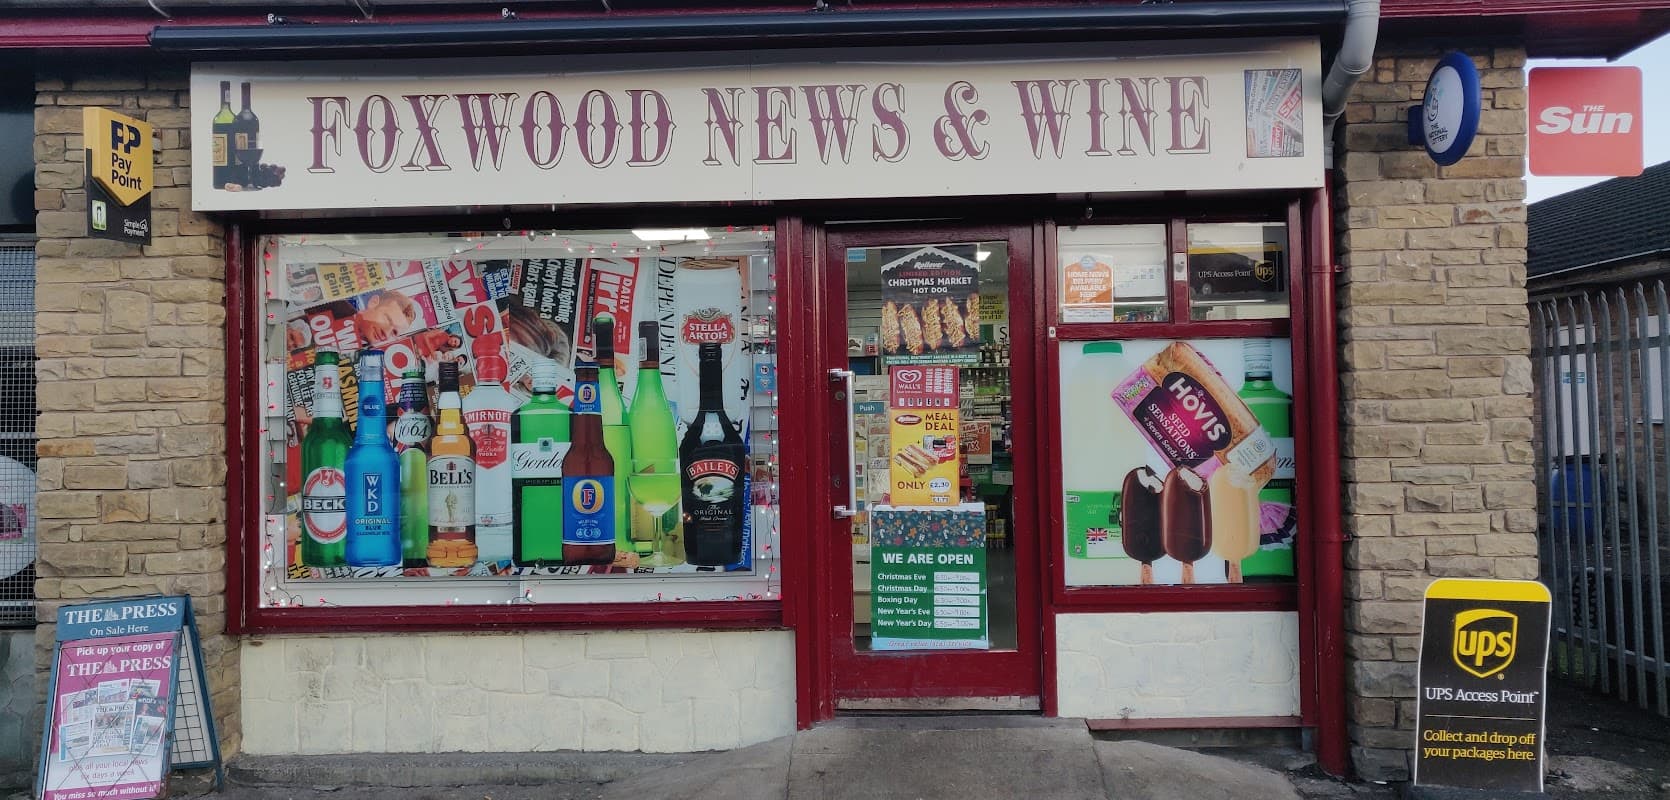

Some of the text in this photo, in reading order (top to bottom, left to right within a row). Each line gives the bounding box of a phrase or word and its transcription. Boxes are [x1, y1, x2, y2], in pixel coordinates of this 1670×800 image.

[1583, 104, 1605, 112] THE
[307, 88, 676, 173] FOXWOOD
[701, 83, 910, 167] NEWS
[933, 80, 990, 160] &
[1010, 76, 1211, 161] WINE
[1536, 106, 1633, 135] Sun
[111, 152, 132, 174] Pay
[111, 170, 142, 190] Point
[541, 259, 560, 289] Cheryl
[1198, 270, 1251, 279] UPS Access Point
[1257, 265, 1273, 278] ups
[324, 272, 340, 297] gain
[888, 277, 972, 287] CHRISTMAS MARKET
[522, 283, 538, 308] again
[619, 278, 632, 313] DAILY
[689, 322, 727, 332] STELLA
[689, 330, 728, 340] ARTOIS
[925, 413, 954, 421] MEAL
[1168, 377, 1227, 443] HOVIS
[925, 423, 955, 431] DEAL
[1148, 403, 1197, 459] SENSATIONS
[1168, 412, 1191, 438] SEED
[1146, 420, 1179, 460] Seven Seeds
[689, 460, 737, 477] BAILEYS
[430, 469, 473, 485] BELL'S
[897, 481, 925, 489] ONLY
[882, 553, 974, 565] WE ARE OPEN
[877, 584, 912, 592] Christmas
[914, 585, 928, 593] Day
[877, 596, 918, 604] Boxing Day
[65, 602, 177, 625] THE PRESS
[90, 624, 149, 636] On Sale Here
[896, 619, 916, 627] Year's
[918, 620, 932, 628] Day
[77, 641, 165, 656] Pick up your copy of
[1458, 630, 1512, 666] ups
[67, 656, 171, 677] THE PRESS
[1425, 687, 1453, 701] UPS
[1454, 688, 1498, 703] Access
[1424, 730, 1536, 746] Collect and drop off
[1424, 747, 1536, 761] your packages here.
[86, 762, 94, 770] all
[96, 762, 110, 771] your
[112, 759, 128, 768] local
[92, 772, 108, 780] days
[98, 789, 117, 797] much
[120, 786, 147, 795] without
